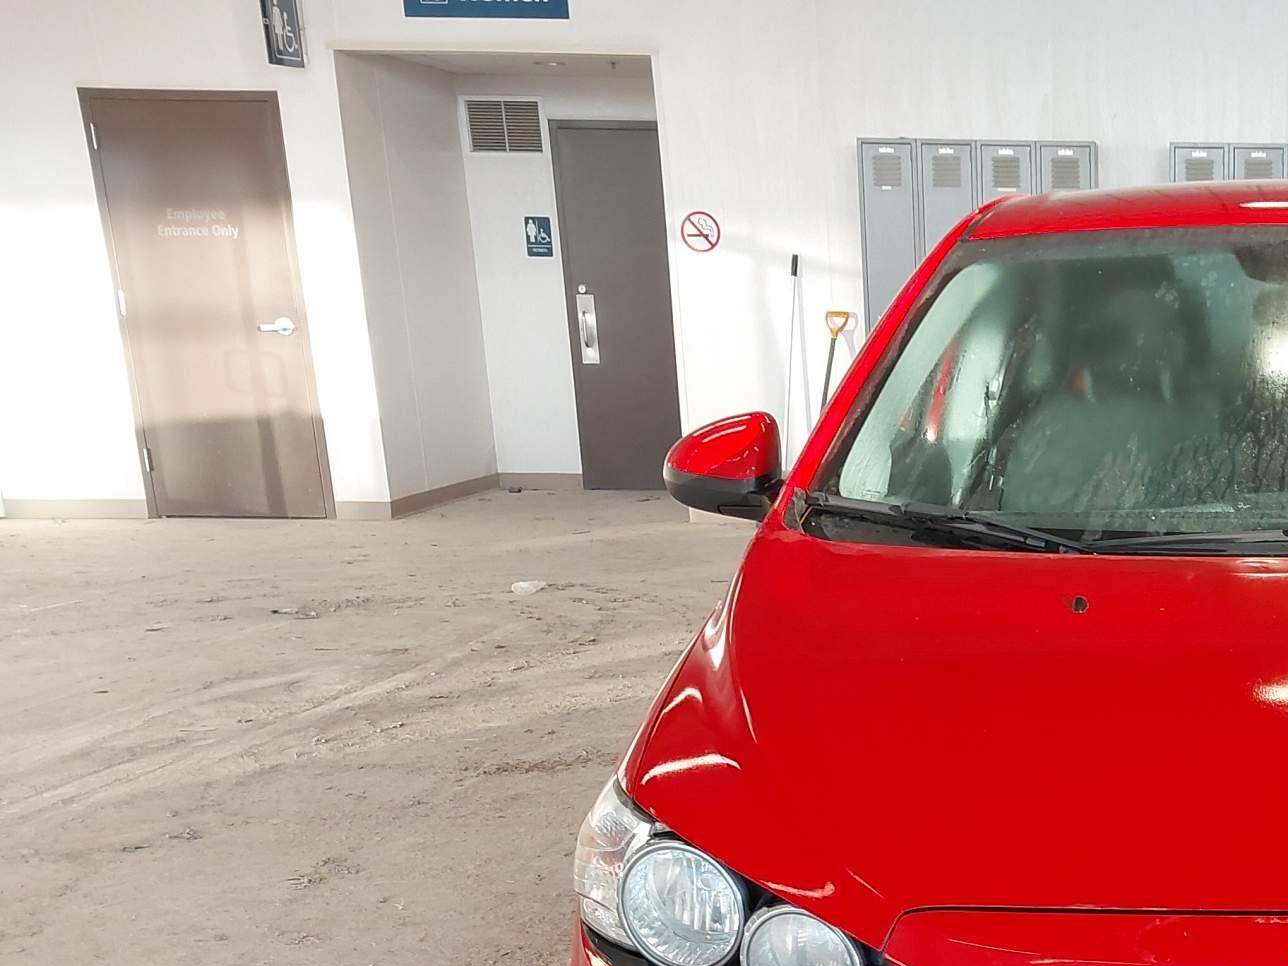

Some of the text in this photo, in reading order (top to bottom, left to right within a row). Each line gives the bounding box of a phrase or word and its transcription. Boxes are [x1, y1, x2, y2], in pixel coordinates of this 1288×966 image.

[166, 207, 225, 223] Employee
[158, 223, 239, 240] Entrance Only
